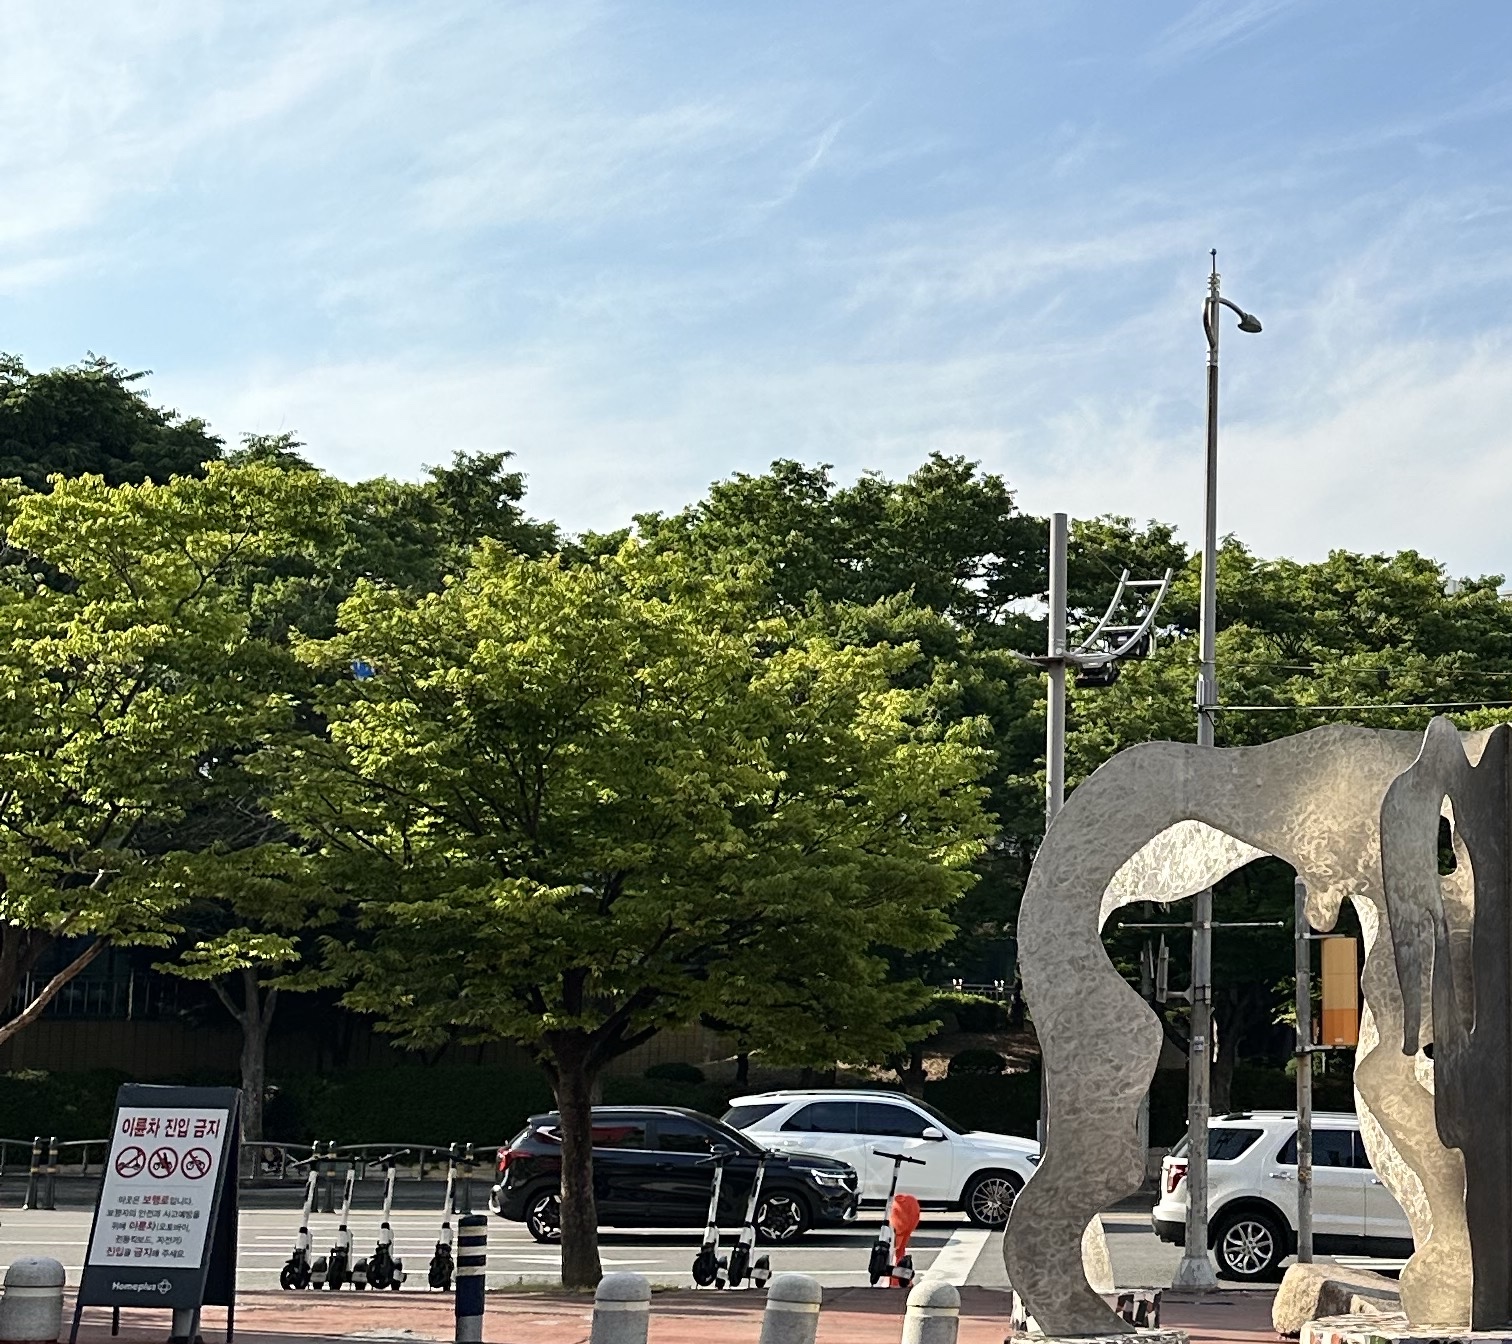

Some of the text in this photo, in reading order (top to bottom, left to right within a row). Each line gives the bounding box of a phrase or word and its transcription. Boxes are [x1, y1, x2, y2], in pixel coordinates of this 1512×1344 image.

[122, 1117, 220, 1139] 이륜차 진입 금지
[111, 1281, 157, 1293] Homeplus
